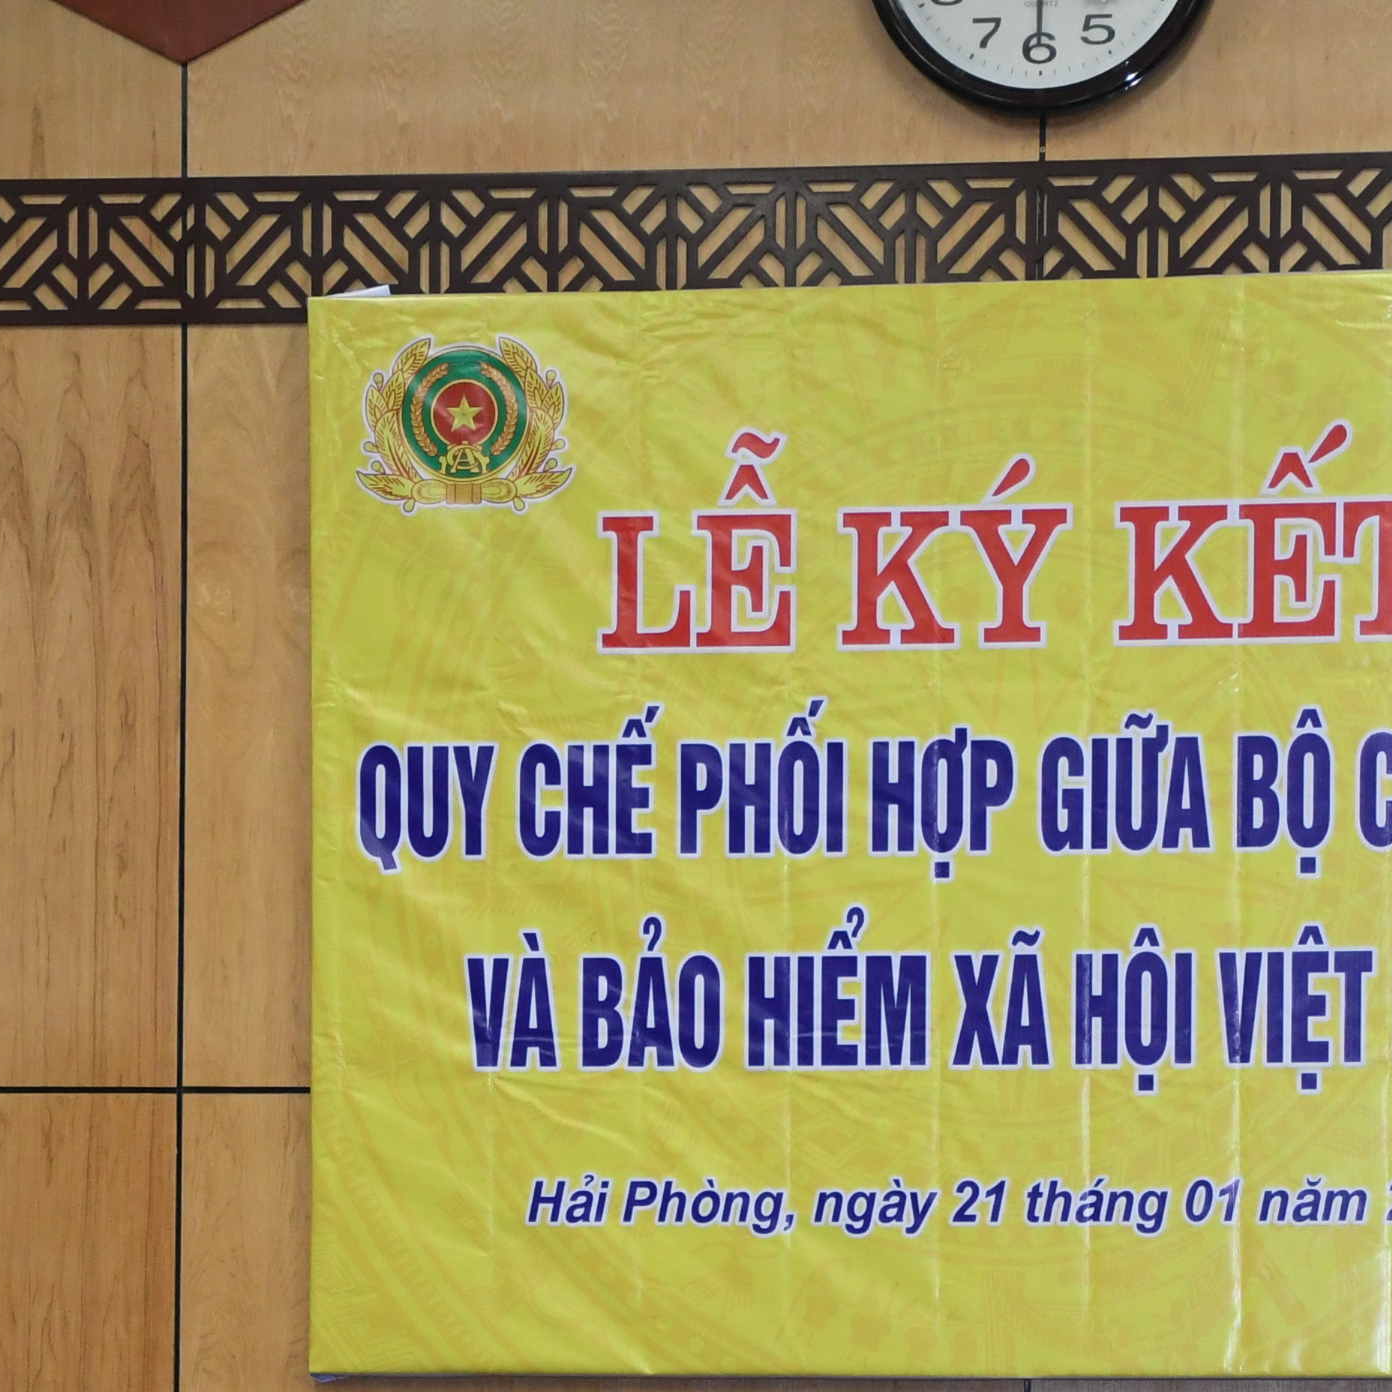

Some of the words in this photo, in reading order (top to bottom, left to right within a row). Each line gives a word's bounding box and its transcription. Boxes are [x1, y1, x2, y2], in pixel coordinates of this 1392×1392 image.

[1024, 0, 1059, 8] QURTZ
[972, 17, 1002, 49] 7
[1022, 32, 1058, 64] 6
[1080, 14, 1116, 45] 5
[602, 432, 792, 649] LỄ
[842, 459, 1067, 645] KÝ
[359, 744, 495, 871] QUY
[519, 705, 660, 857] CHẾ
[679, 699, 844, 855] PHỐI
[871, 727, 1014, 879] HỢP
[1040, 712, 1211, 852] GIỮA
[1236, 708, 1331, 874] BỘ
[466, 932, 558, 1068] VÀ
[581, 916, 721, 1069] BẢO
[747, 906, 927, 1067] HIỂM
[952, 929, 1050, 1066] XÃ
[1074, 927, 1193, 1092] HỘI
[1218, 925, 1373, 1090] VIỆT
[527, 1174, 610, 1224] Hải
[622, 1178, 795, 1235] Phòng,
[813, 1178, 938, 1235] ngày
[952, 1179, 1006, 1223] 21
[1026, 1178, 1169, 1234] tháng
[1185, 1179, 1240, 1223] 01
[1258, 1177, 1367, 1223] năm
